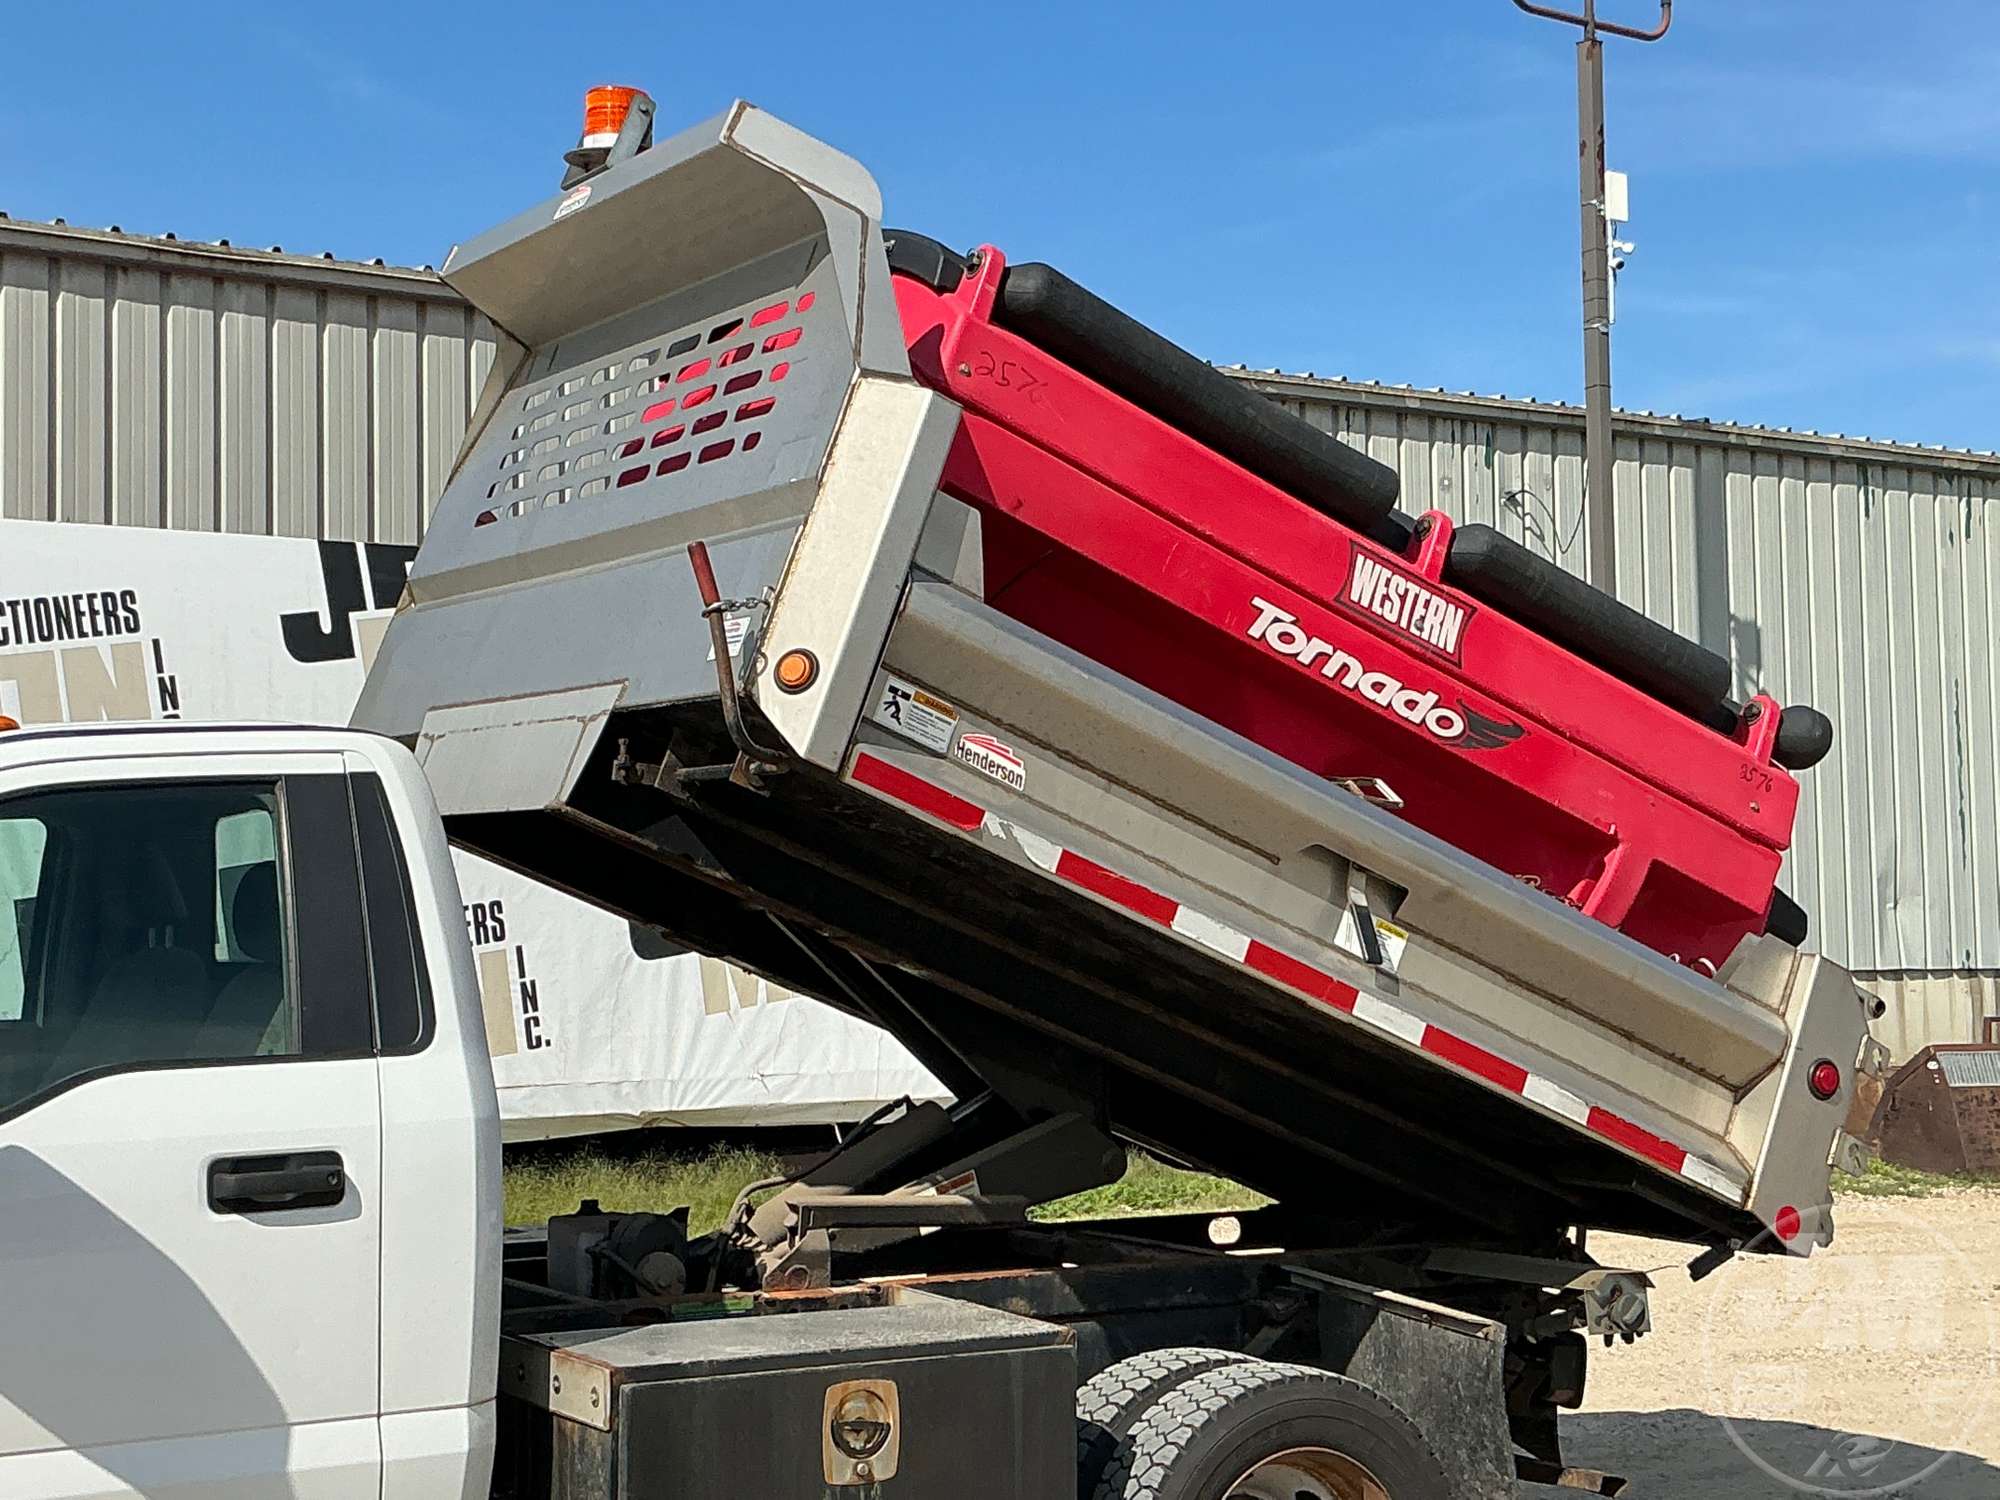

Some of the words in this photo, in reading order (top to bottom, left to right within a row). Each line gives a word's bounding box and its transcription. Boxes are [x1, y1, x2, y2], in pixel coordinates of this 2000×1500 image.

[1350, 552, 1464, 654] WESTERN
[1247, 596, 1465, 738] Tornado
[956, 740, 1023, 789] Henderson
